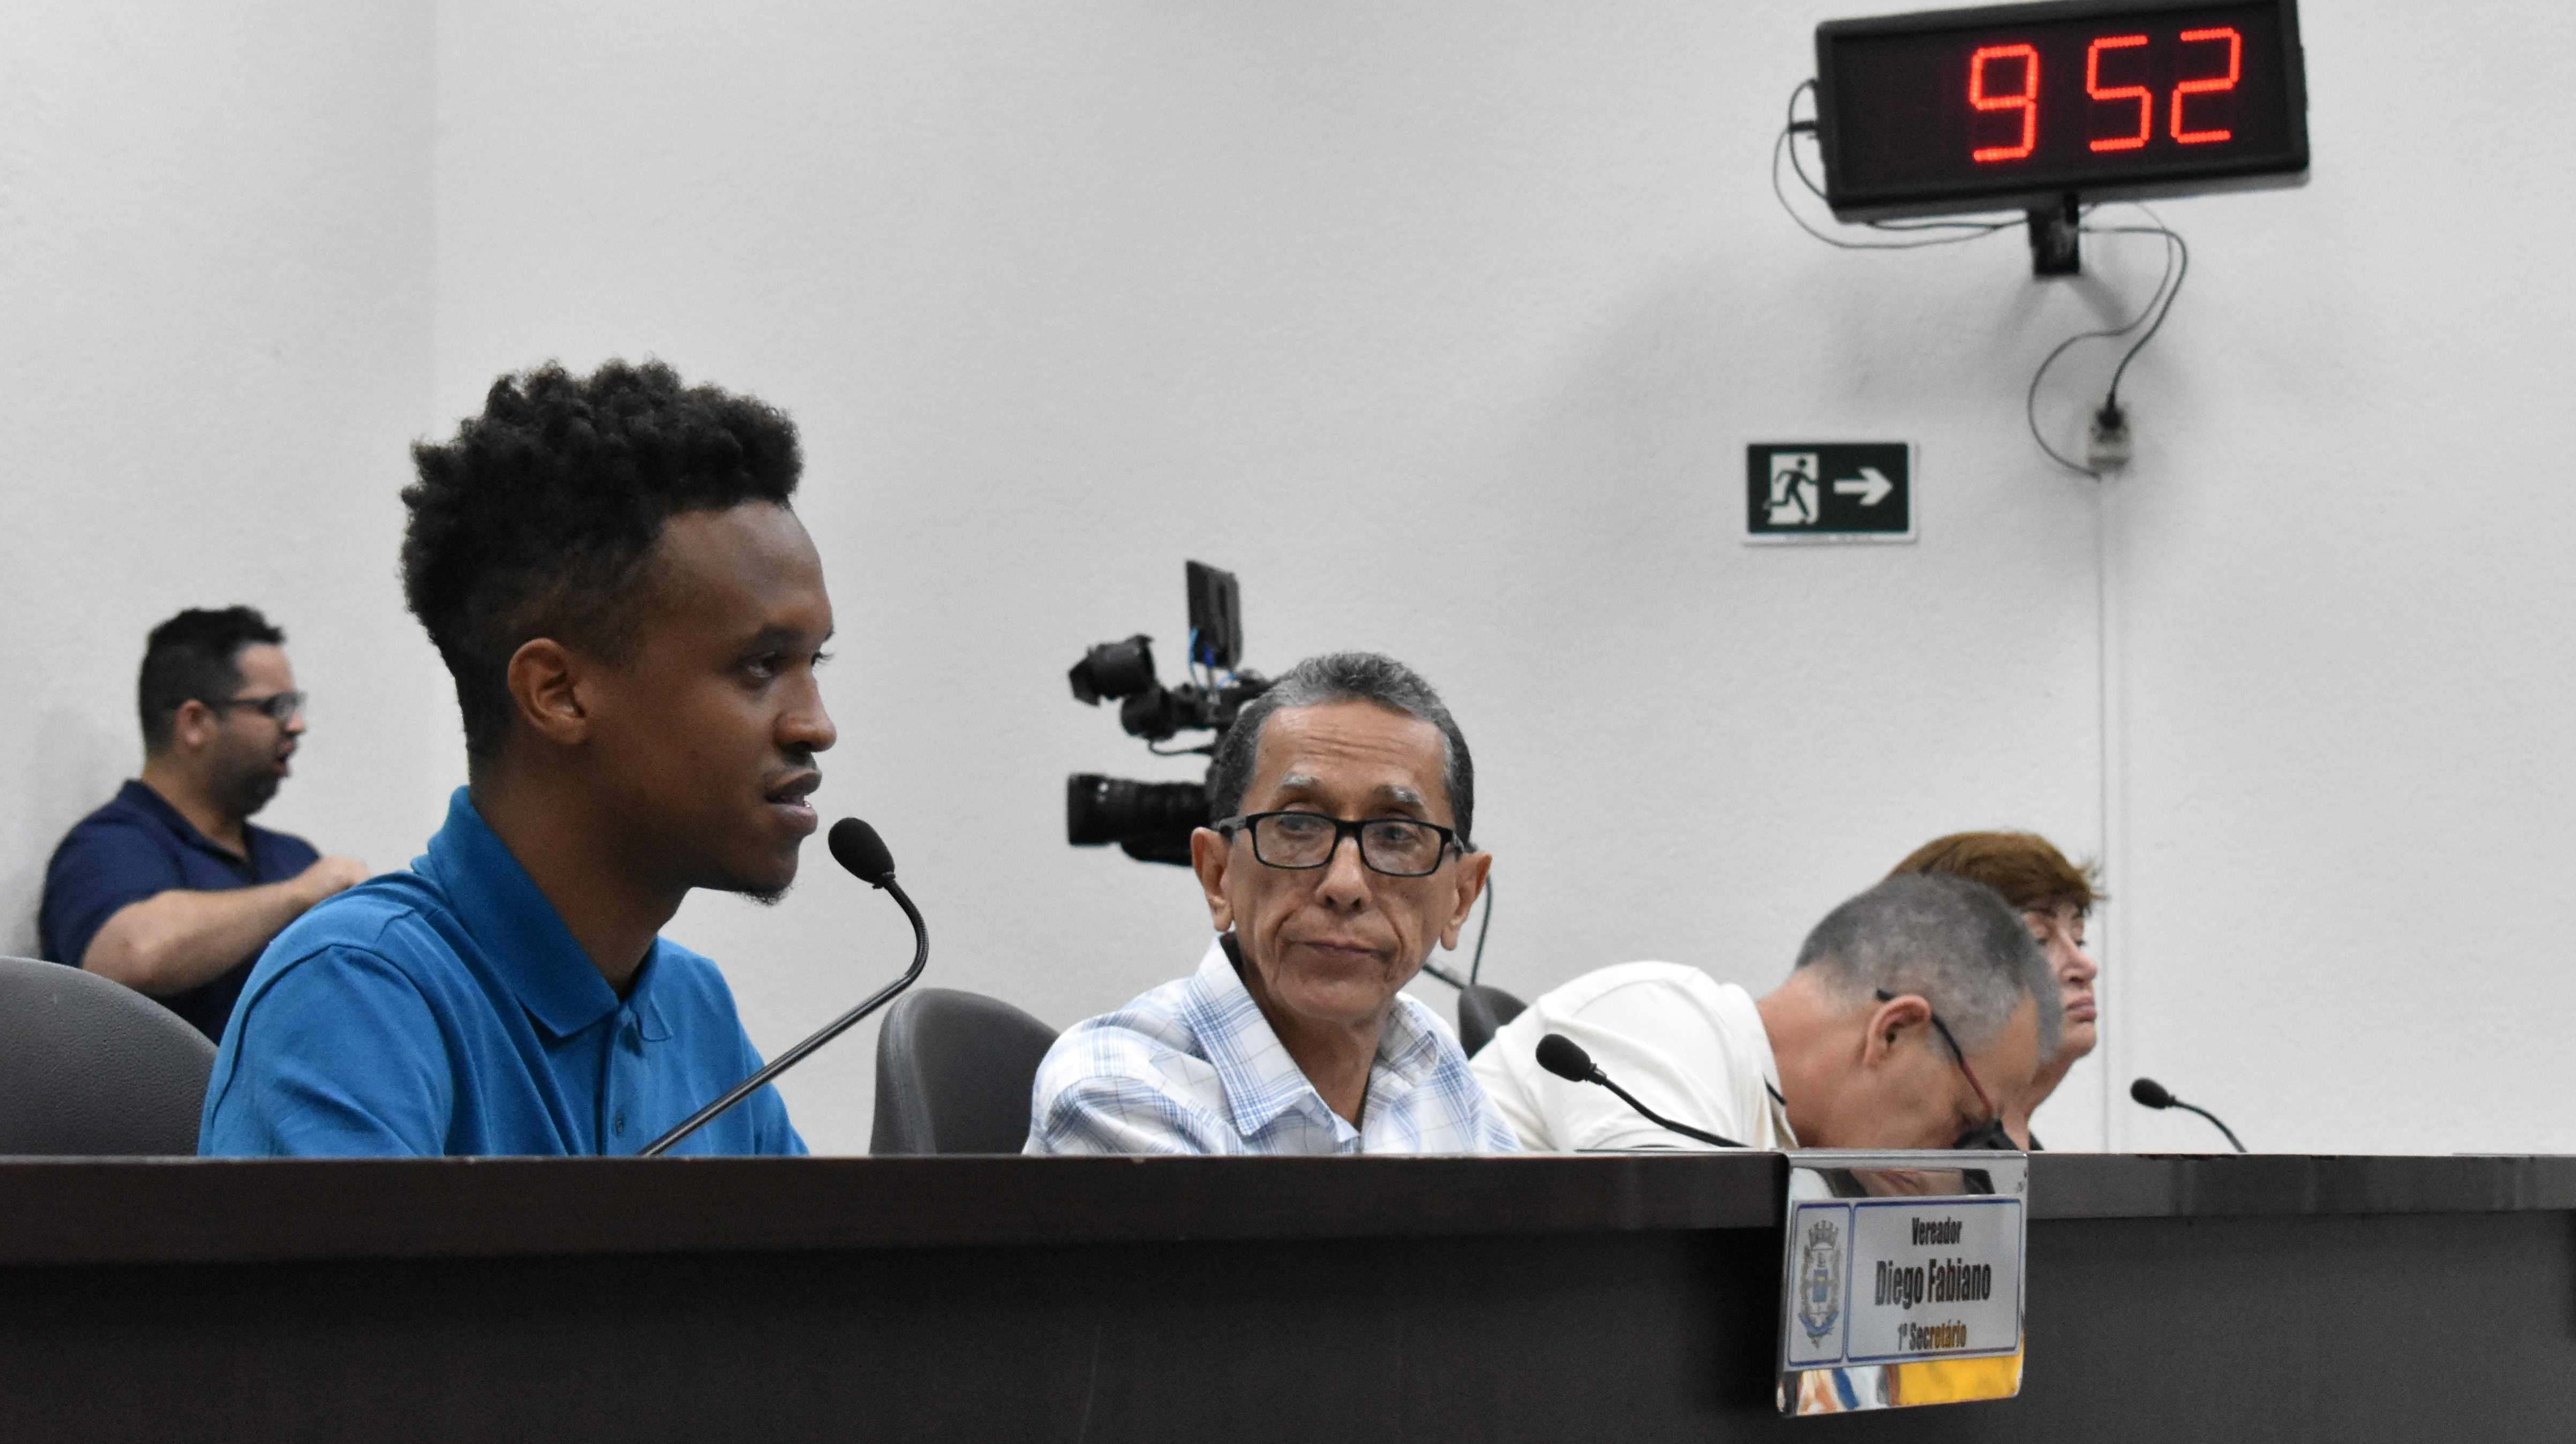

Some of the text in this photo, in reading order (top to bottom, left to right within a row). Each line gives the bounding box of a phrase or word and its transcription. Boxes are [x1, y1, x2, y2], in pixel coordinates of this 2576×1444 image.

[1971, 27, 2241, 161] 9 52
[1912, 1216, 1962, 1245] Vereador
[1875, 1258, 1992, 1309] Diego Fabiano
[1909, 1319, 1966, 1351] Secretário
